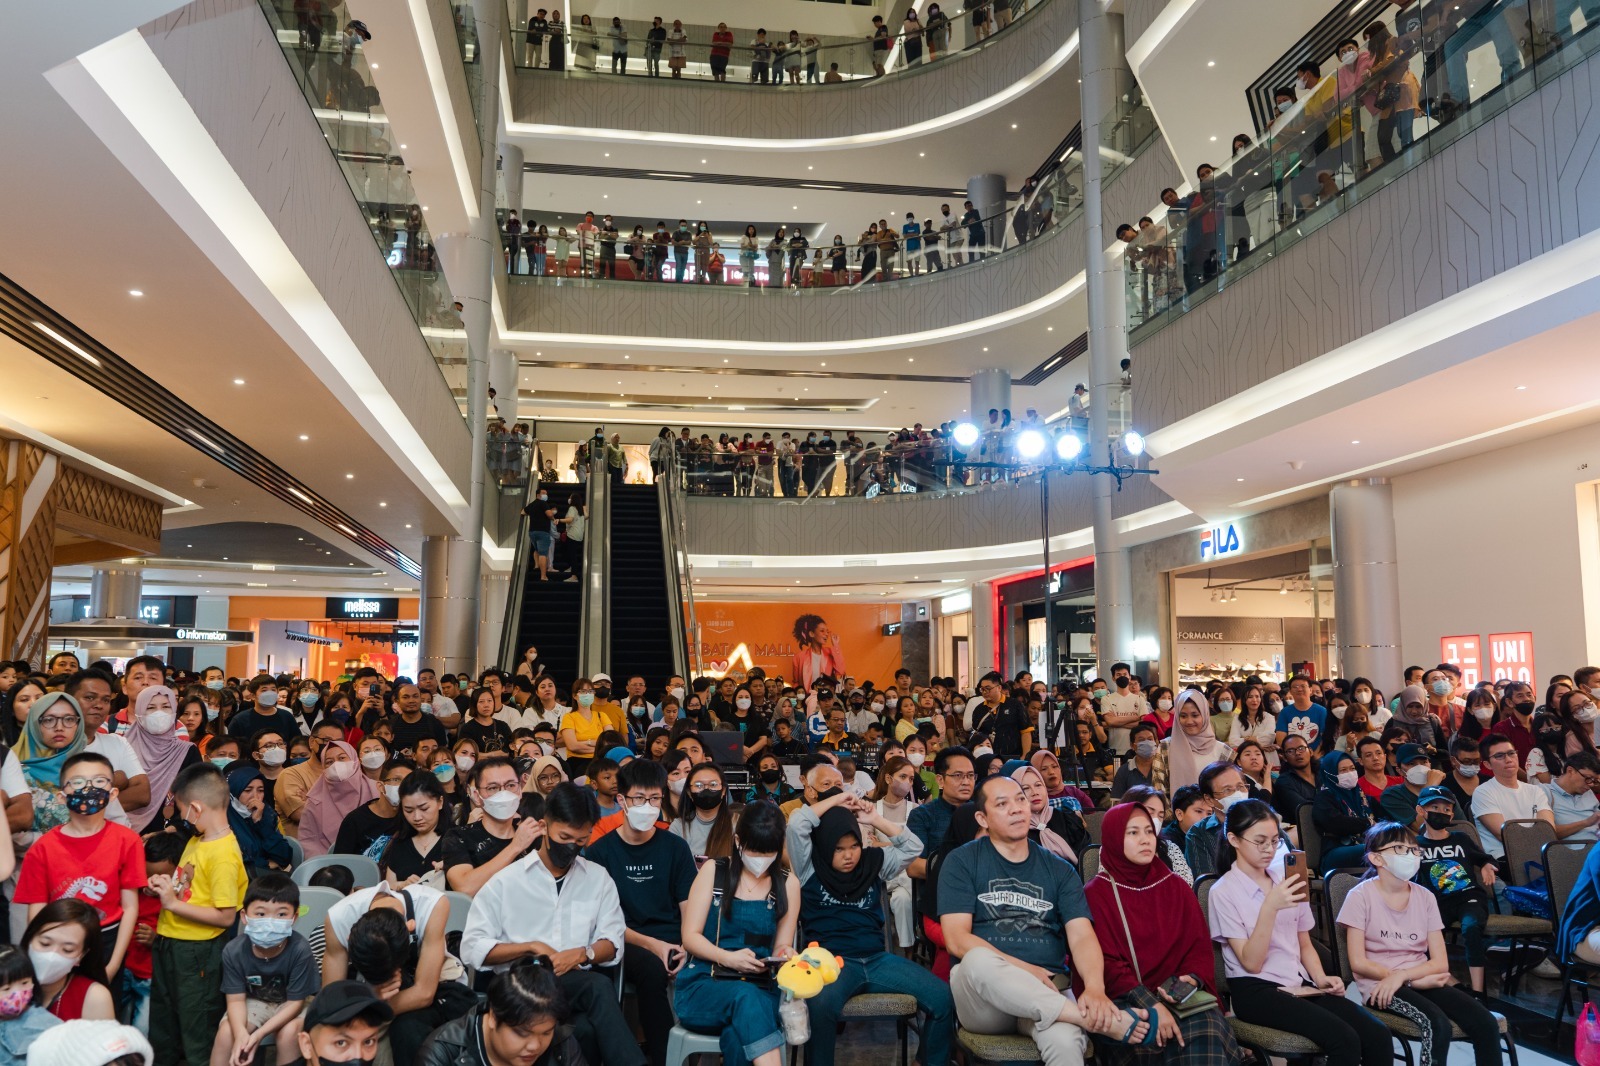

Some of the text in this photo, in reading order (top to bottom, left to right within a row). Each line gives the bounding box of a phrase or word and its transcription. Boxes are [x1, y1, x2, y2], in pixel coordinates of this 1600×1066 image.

[1200, 524, 1240, 558] FILA
[344, 599, 380, 613] melissa
[185, 629, 227, 641] information
[754, 643, 795, 657] MALL
[1492, 640, 1526, 663] UNI
[1420, 844, 1466, 860] NASA
[993, 892, 1040, 910] HARD ROCK
